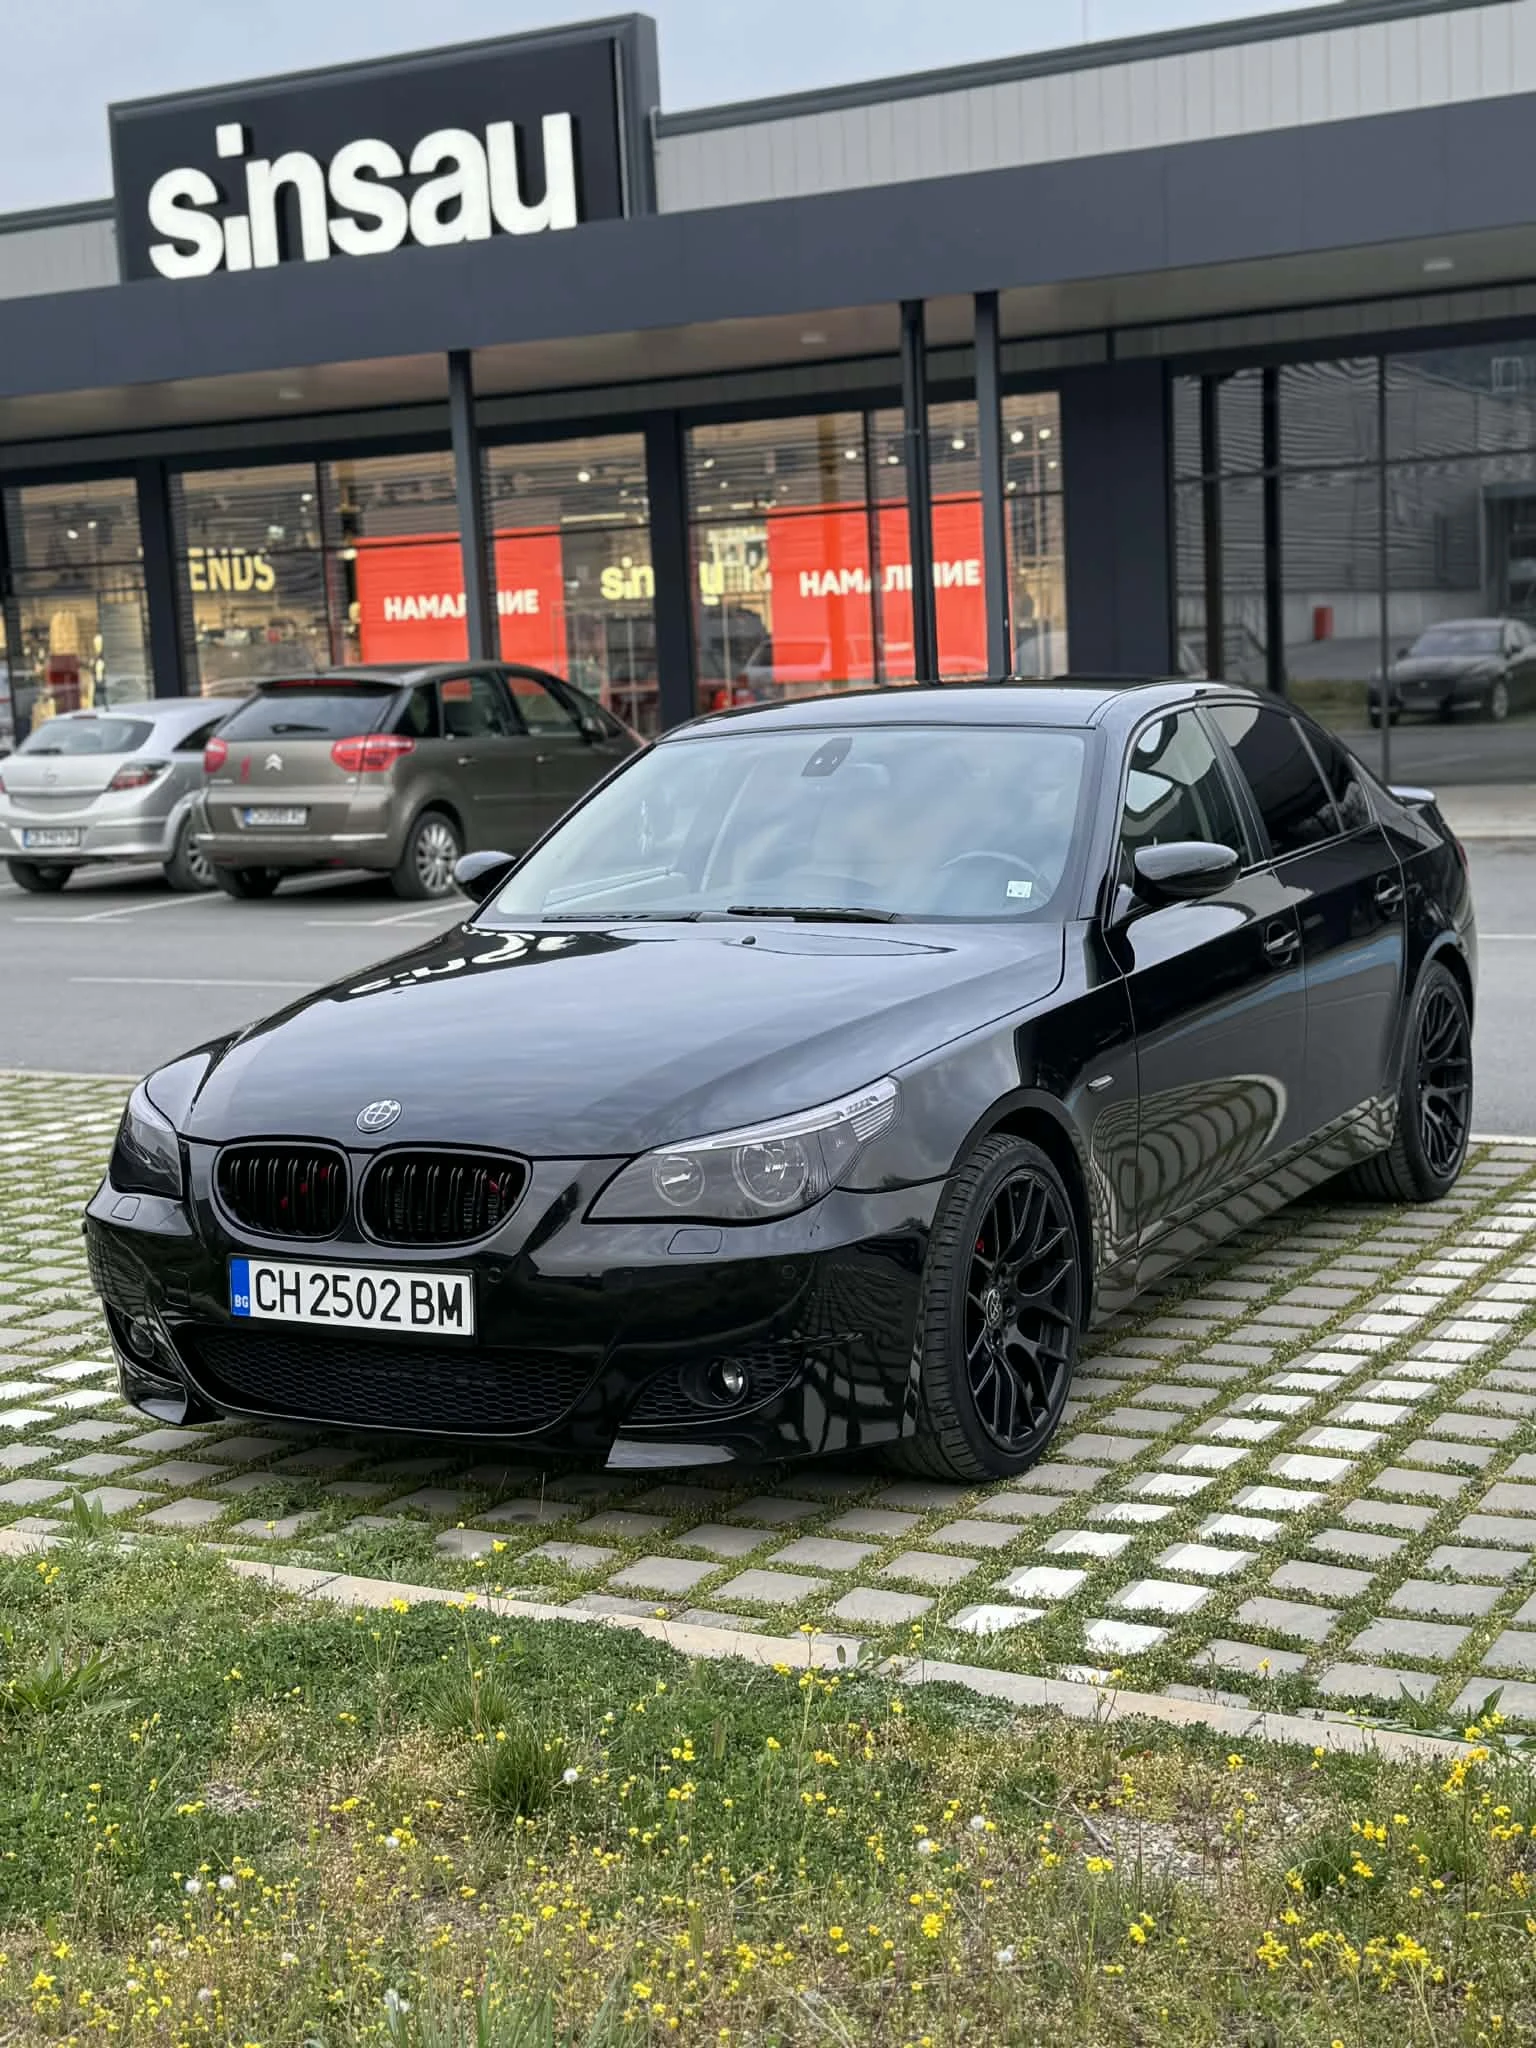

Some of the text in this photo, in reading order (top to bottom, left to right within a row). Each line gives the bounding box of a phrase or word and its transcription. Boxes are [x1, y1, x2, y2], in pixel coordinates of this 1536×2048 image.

[147, 112, 578, 280] sinsau
[233, 1294, 249, 1310] BG
[255, 1268, 463, 1328] CH 2502 BM
